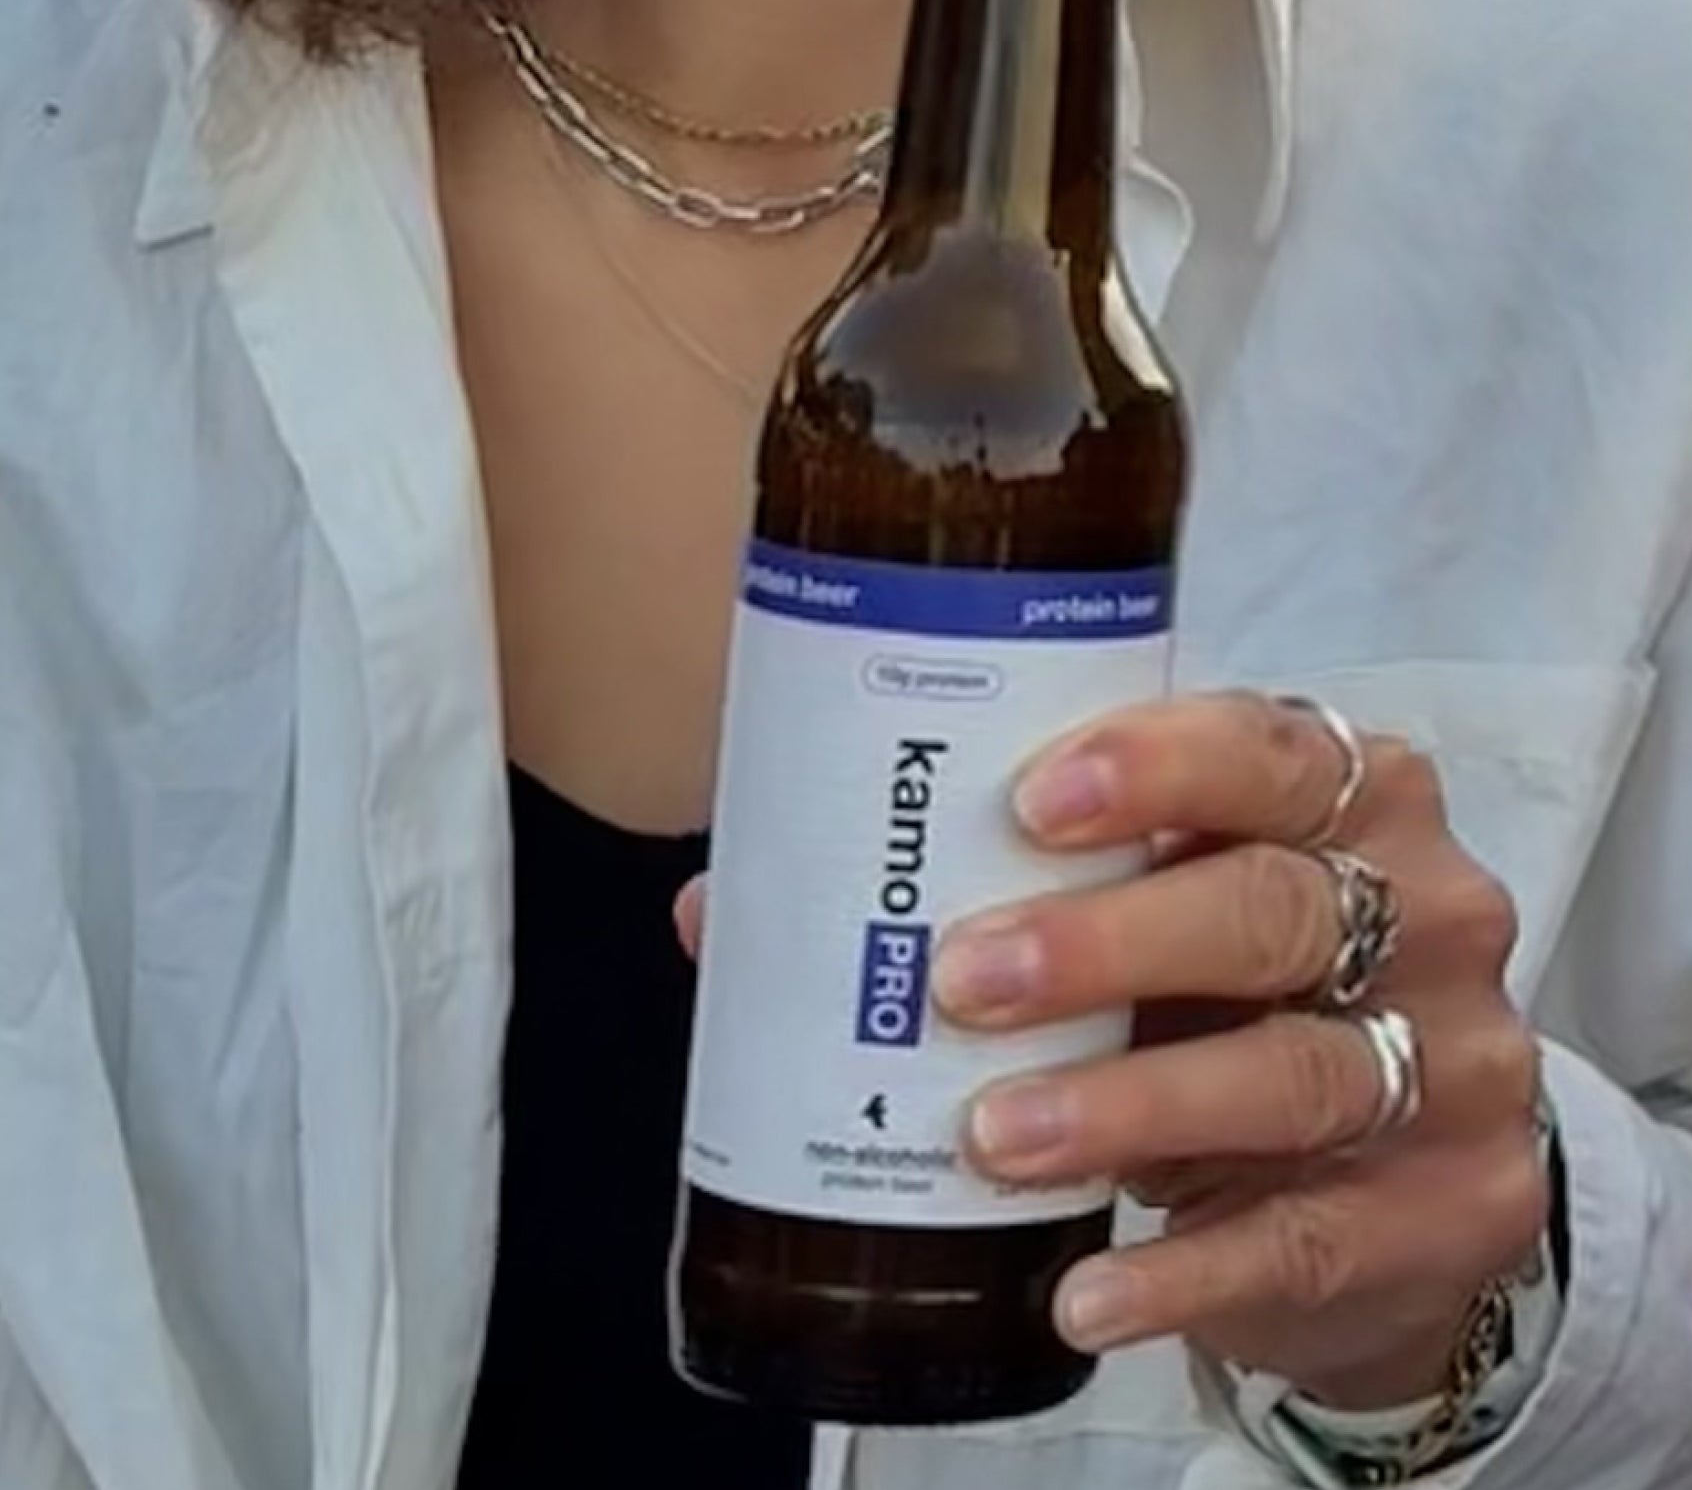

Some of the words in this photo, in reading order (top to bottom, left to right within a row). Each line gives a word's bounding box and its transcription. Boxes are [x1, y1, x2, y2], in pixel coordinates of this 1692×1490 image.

[1021, 594, 1117, 628] protein
[881, 739, 950, 916] kamo
[867, 931, 917, 1040] PRO
